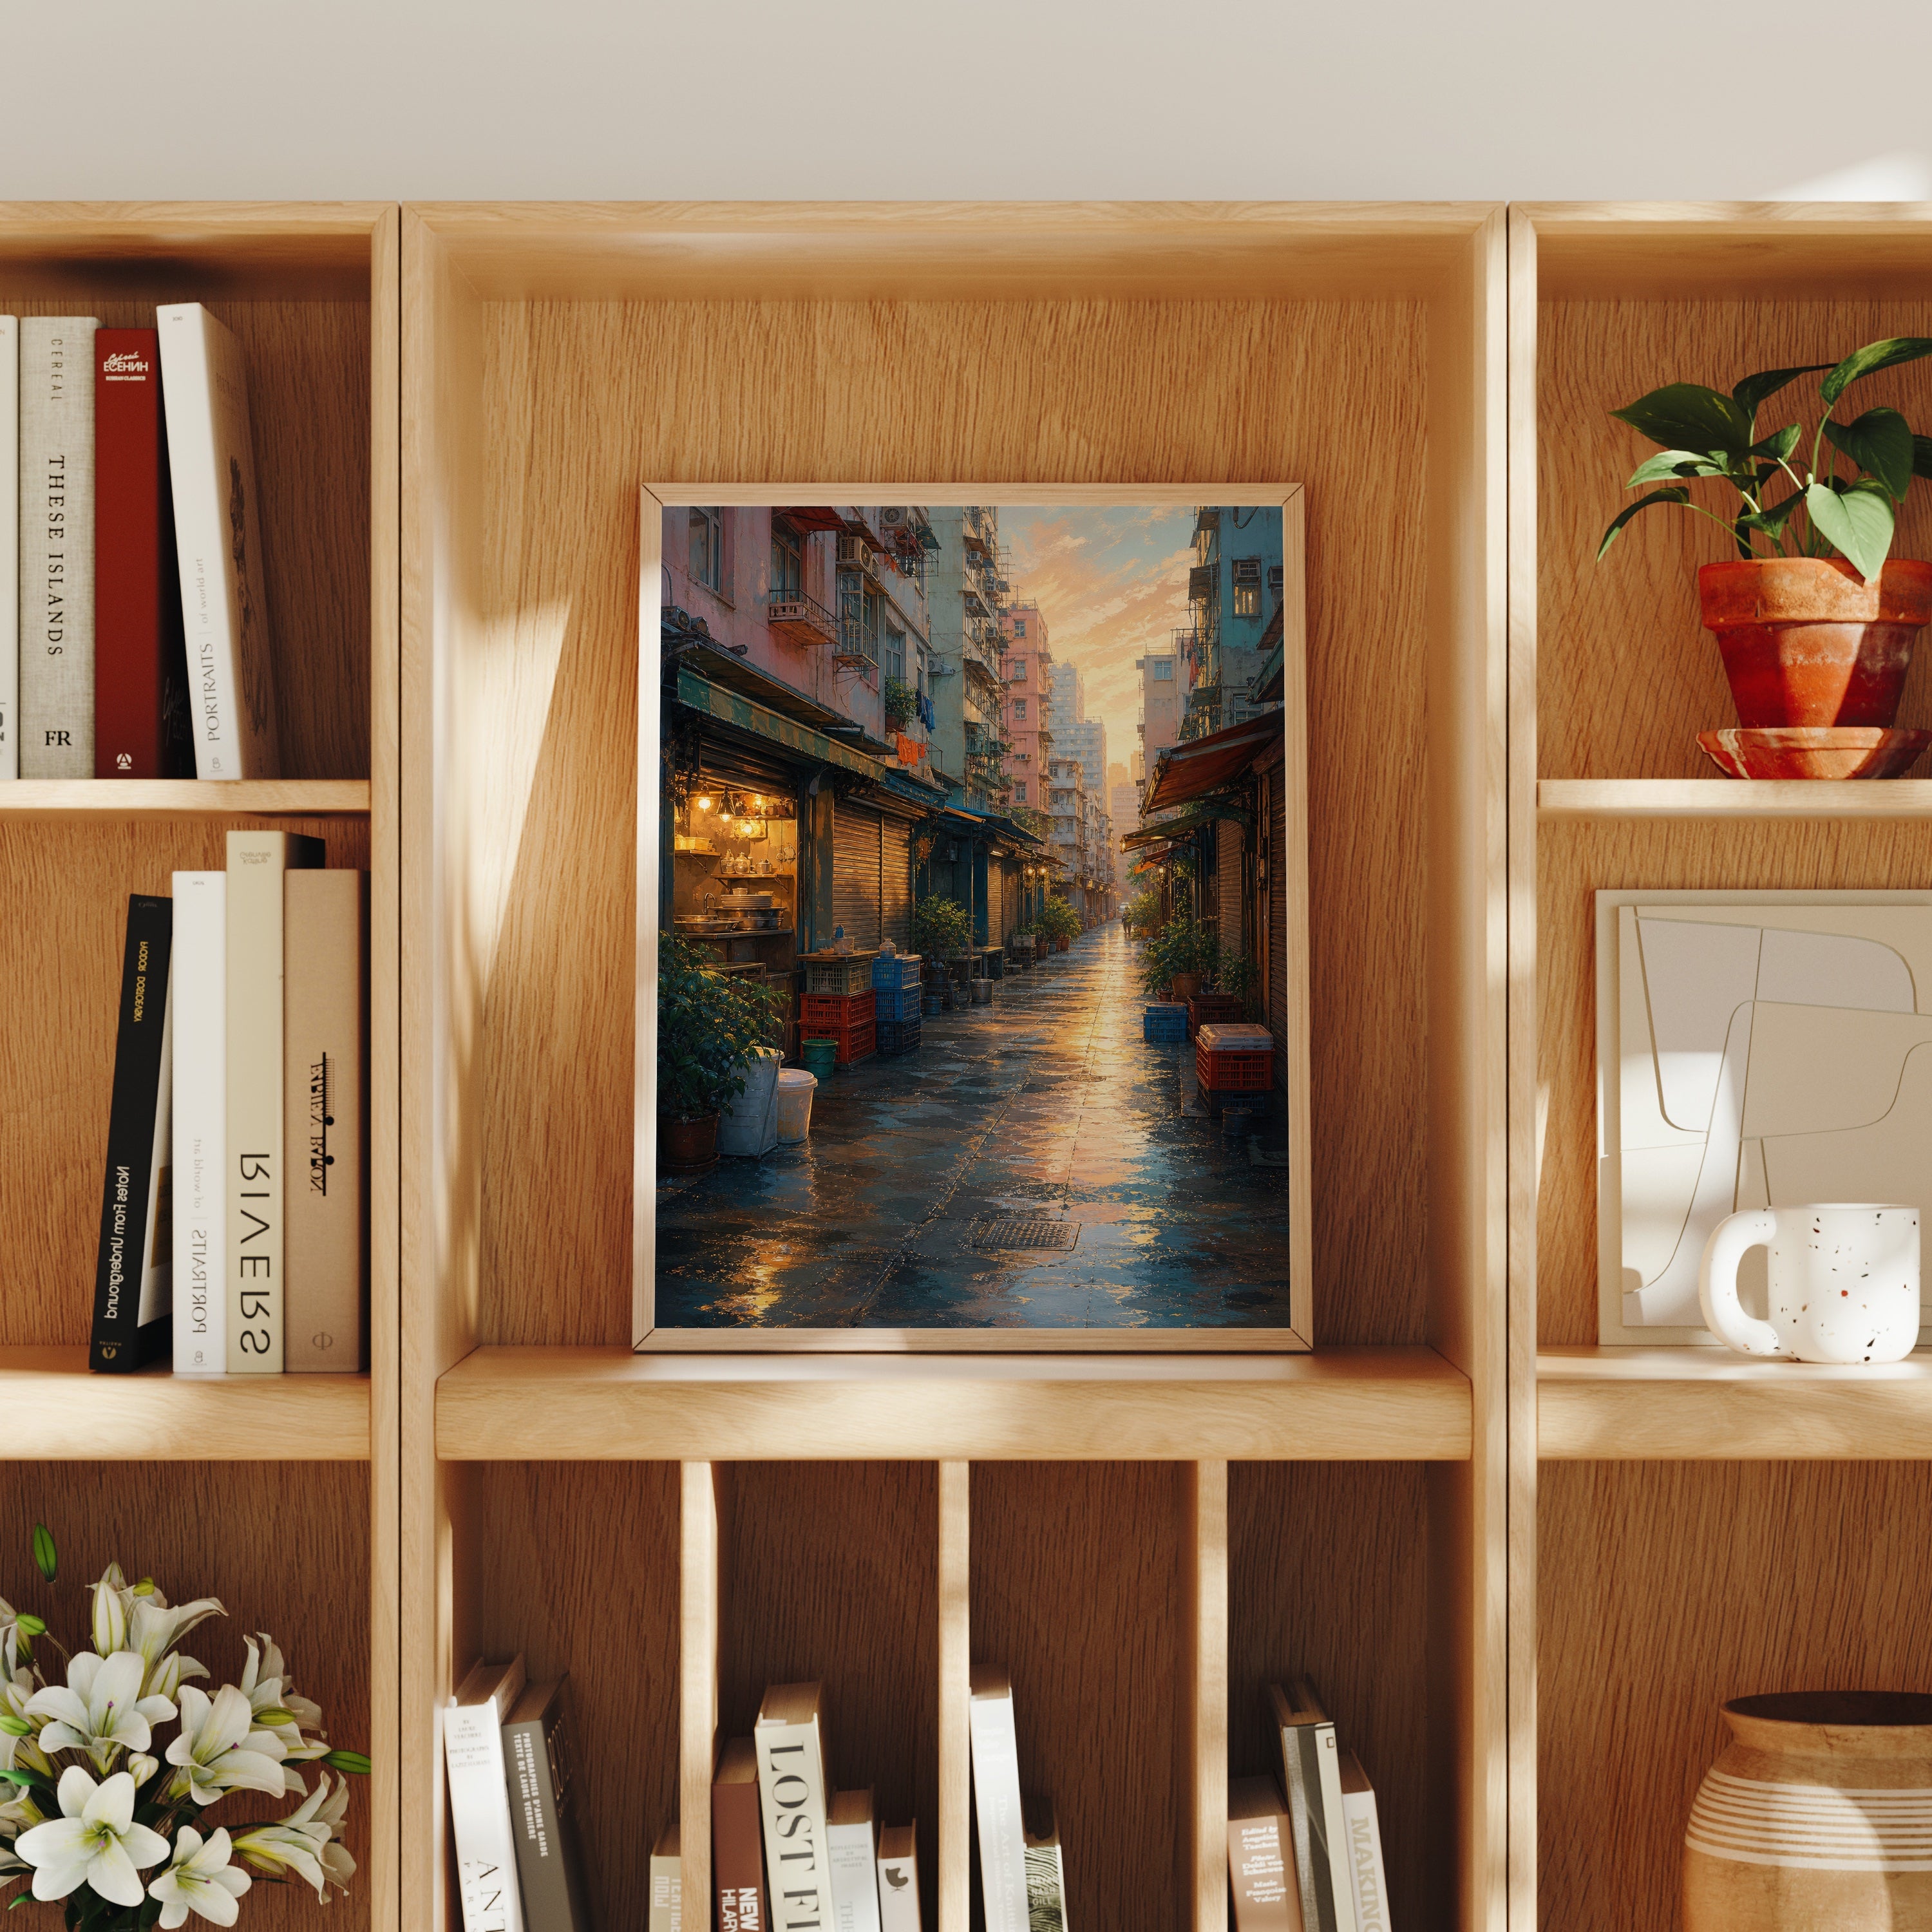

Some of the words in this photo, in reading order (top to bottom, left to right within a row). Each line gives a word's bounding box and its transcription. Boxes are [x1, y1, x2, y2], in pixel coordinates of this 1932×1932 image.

[51, 339, 63, 401] CEREAL
[103, 361, 149, 372] ЕСЕНИН
[48, 455, 65, 539] THESE
[48, 553, 64, 655] ISLANDS
[196, 577, 207, 611] world
[201, 613, 209, 624] of
[200, 643, 220, 741] PORTRAITS
[45, 730, 72, 746] FR
[513, 1734, 524, 1759] TEXTE
[517, 1761, 526, 1771] DE
[522, 1732, 540, 1797] PHOTOGRAPHIES
[519, 1774, 531, 1799] LAURE
[532, 1799, 544, 1828] D'ANNE
[769, 1740, 816, 1871] LOST
[999, 1794, 1009, 1826] The
[537, 1831, 549, 1857] GARDE
[1001, 1830, 1011, 1857] Art
[1241, 1827, 1267, 1836] Edited
[1268, 1825, 1278, 1833] by
[1003, 1862, 1014, 1880] of
[654, 1875, 670, 1908] NOW
[1032, 1897, 1052, 1906] GILL
[738, 1887, 760, 1931] NEW
